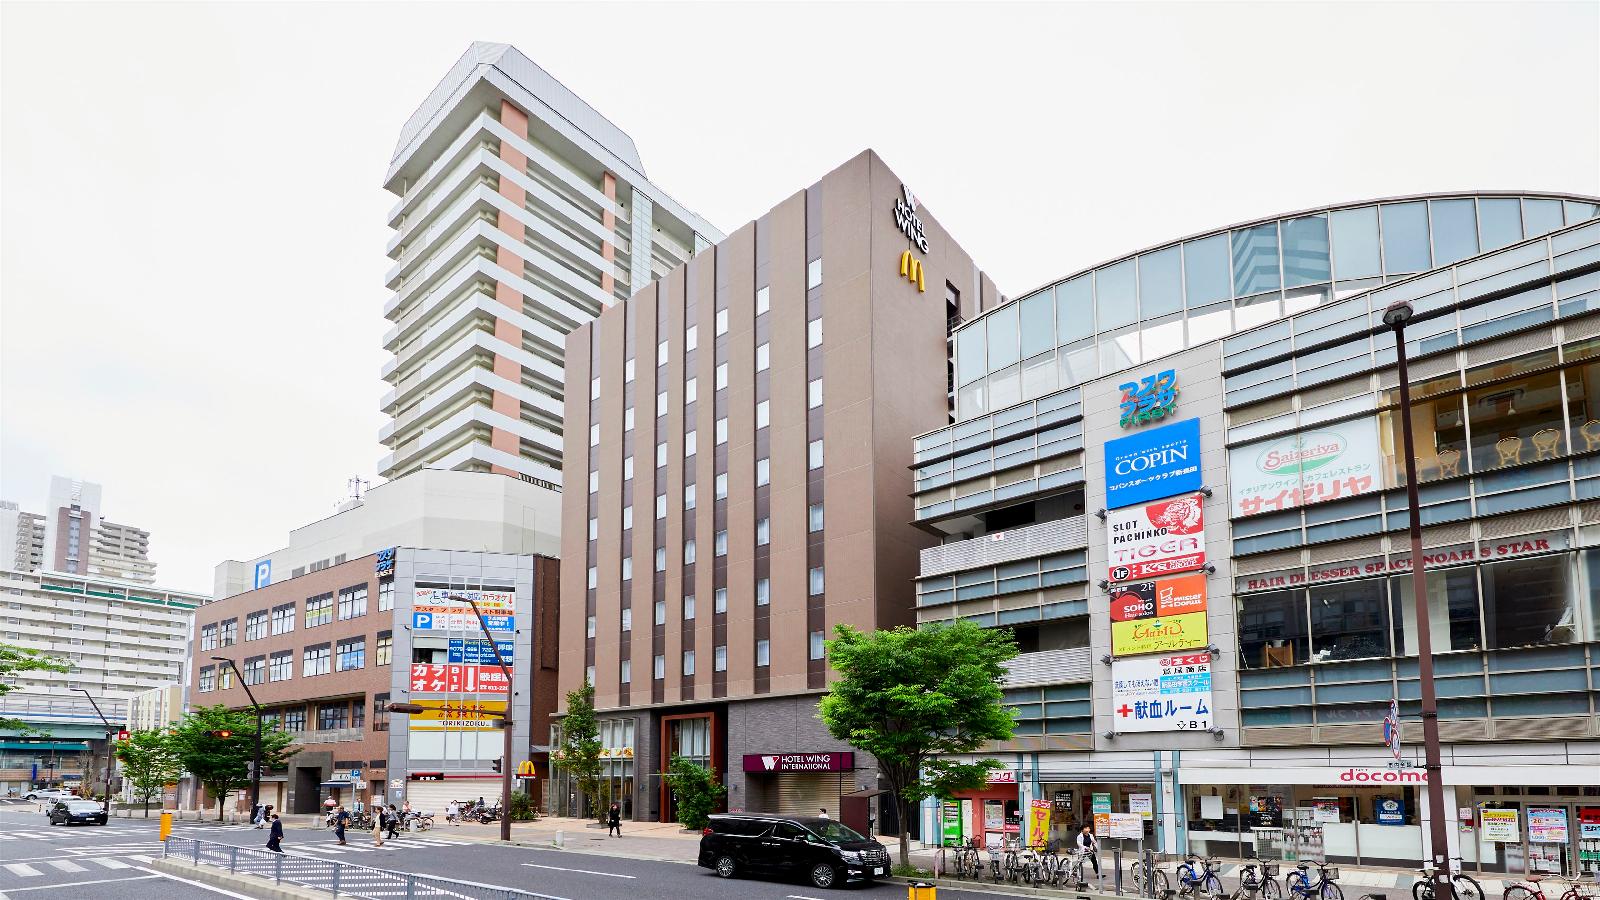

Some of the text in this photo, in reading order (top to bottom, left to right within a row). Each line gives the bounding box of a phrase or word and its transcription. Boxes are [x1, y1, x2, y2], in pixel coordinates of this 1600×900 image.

[897, 198, 926, 239] HOTEL
[894, 208, 929, 255] WING
[1115, 444, 1189, 476] COPIN
[1263, 442, 1340, 470] Saizeriya
[1239, 475, 1372, 516] サイゼリヤ
[1113, 520, 1138, 532] SLOT
[1113, 528, 1168, 544] PACHINKO
[1116, 570, 1128, 579] 1F
[1248, 576, 1286, 589] HAIR
[1496, 539, 1550, 555] STAR
[1140, 582, 1155, 592] 2F
[1123, 602, 1154, 613] SOHO
[1134, 698, 1209, 720] 献血ルーム
[781, 755, 805, 763] HOTEL
[805, 754, 831, 763] WING
[1033, 810, 1046, 837] セール
